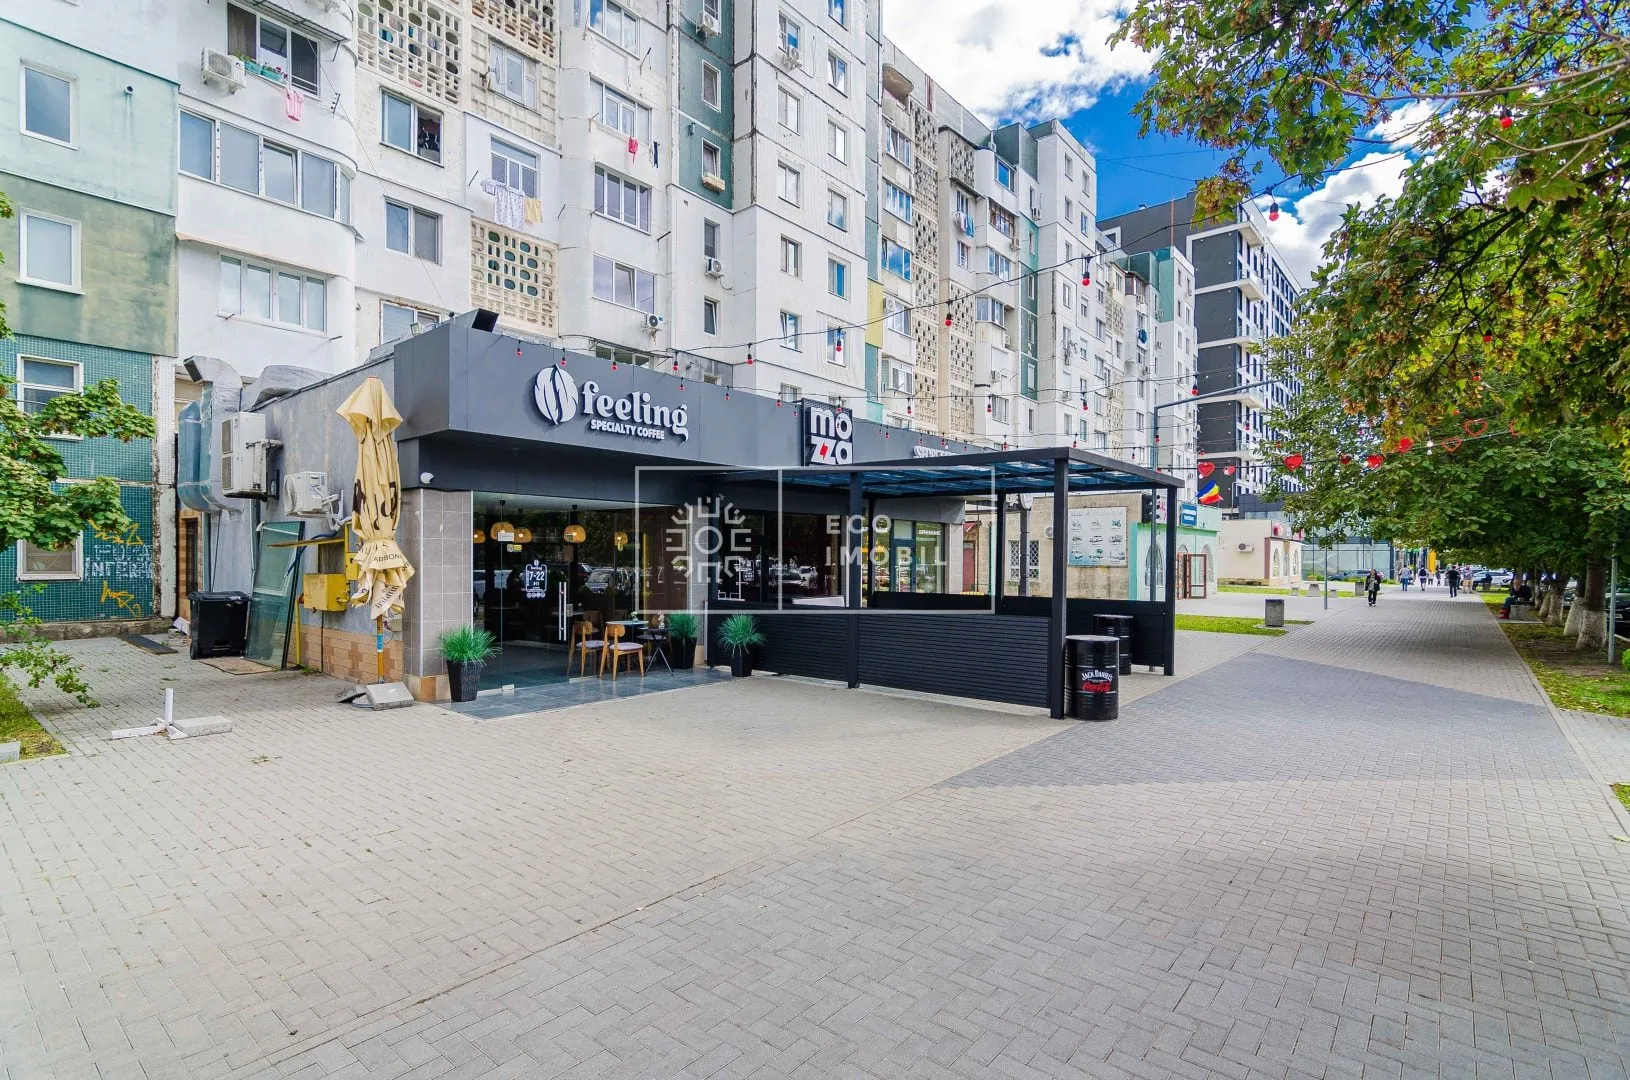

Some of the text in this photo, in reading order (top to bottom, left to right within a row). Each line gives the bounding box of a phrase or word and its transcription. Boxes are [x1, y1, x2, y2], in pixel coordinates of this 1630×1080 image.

[582, 380, 689, 442] feeling
[590, 419, 665, 440] SPECIALTY COFFEE
[810, 406, 852, 440] mo
[529, 571, 545, 581] 7-22
[1081, 671, 1094, 681] JACK
